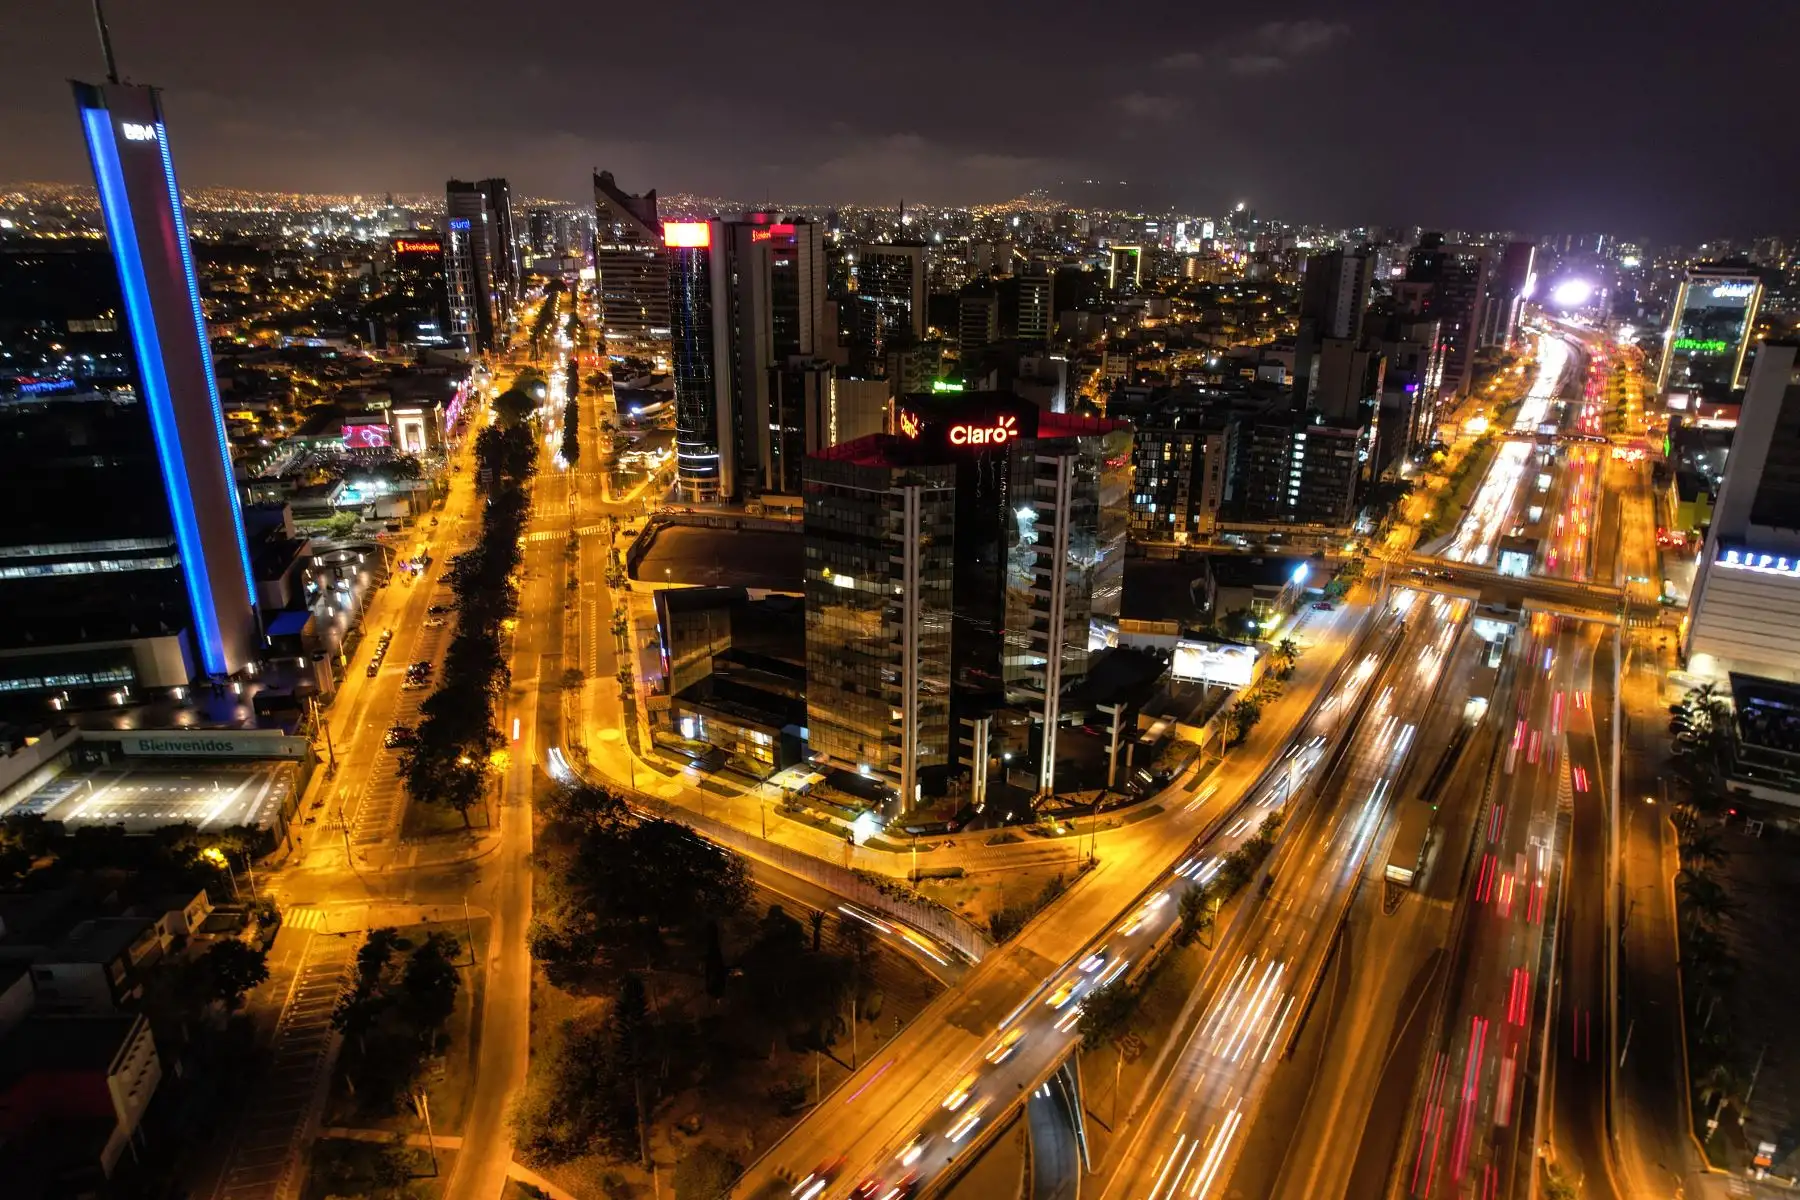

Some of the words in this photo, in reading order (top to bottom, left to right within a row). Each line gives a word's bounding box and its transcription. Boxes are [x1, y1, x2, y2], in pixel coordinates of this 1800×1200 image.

[405, 242, 440, 252] Scotiabank
[950, 424, 1008, 445] Claro
[138, 739, 234, 751] Bienvenidos
